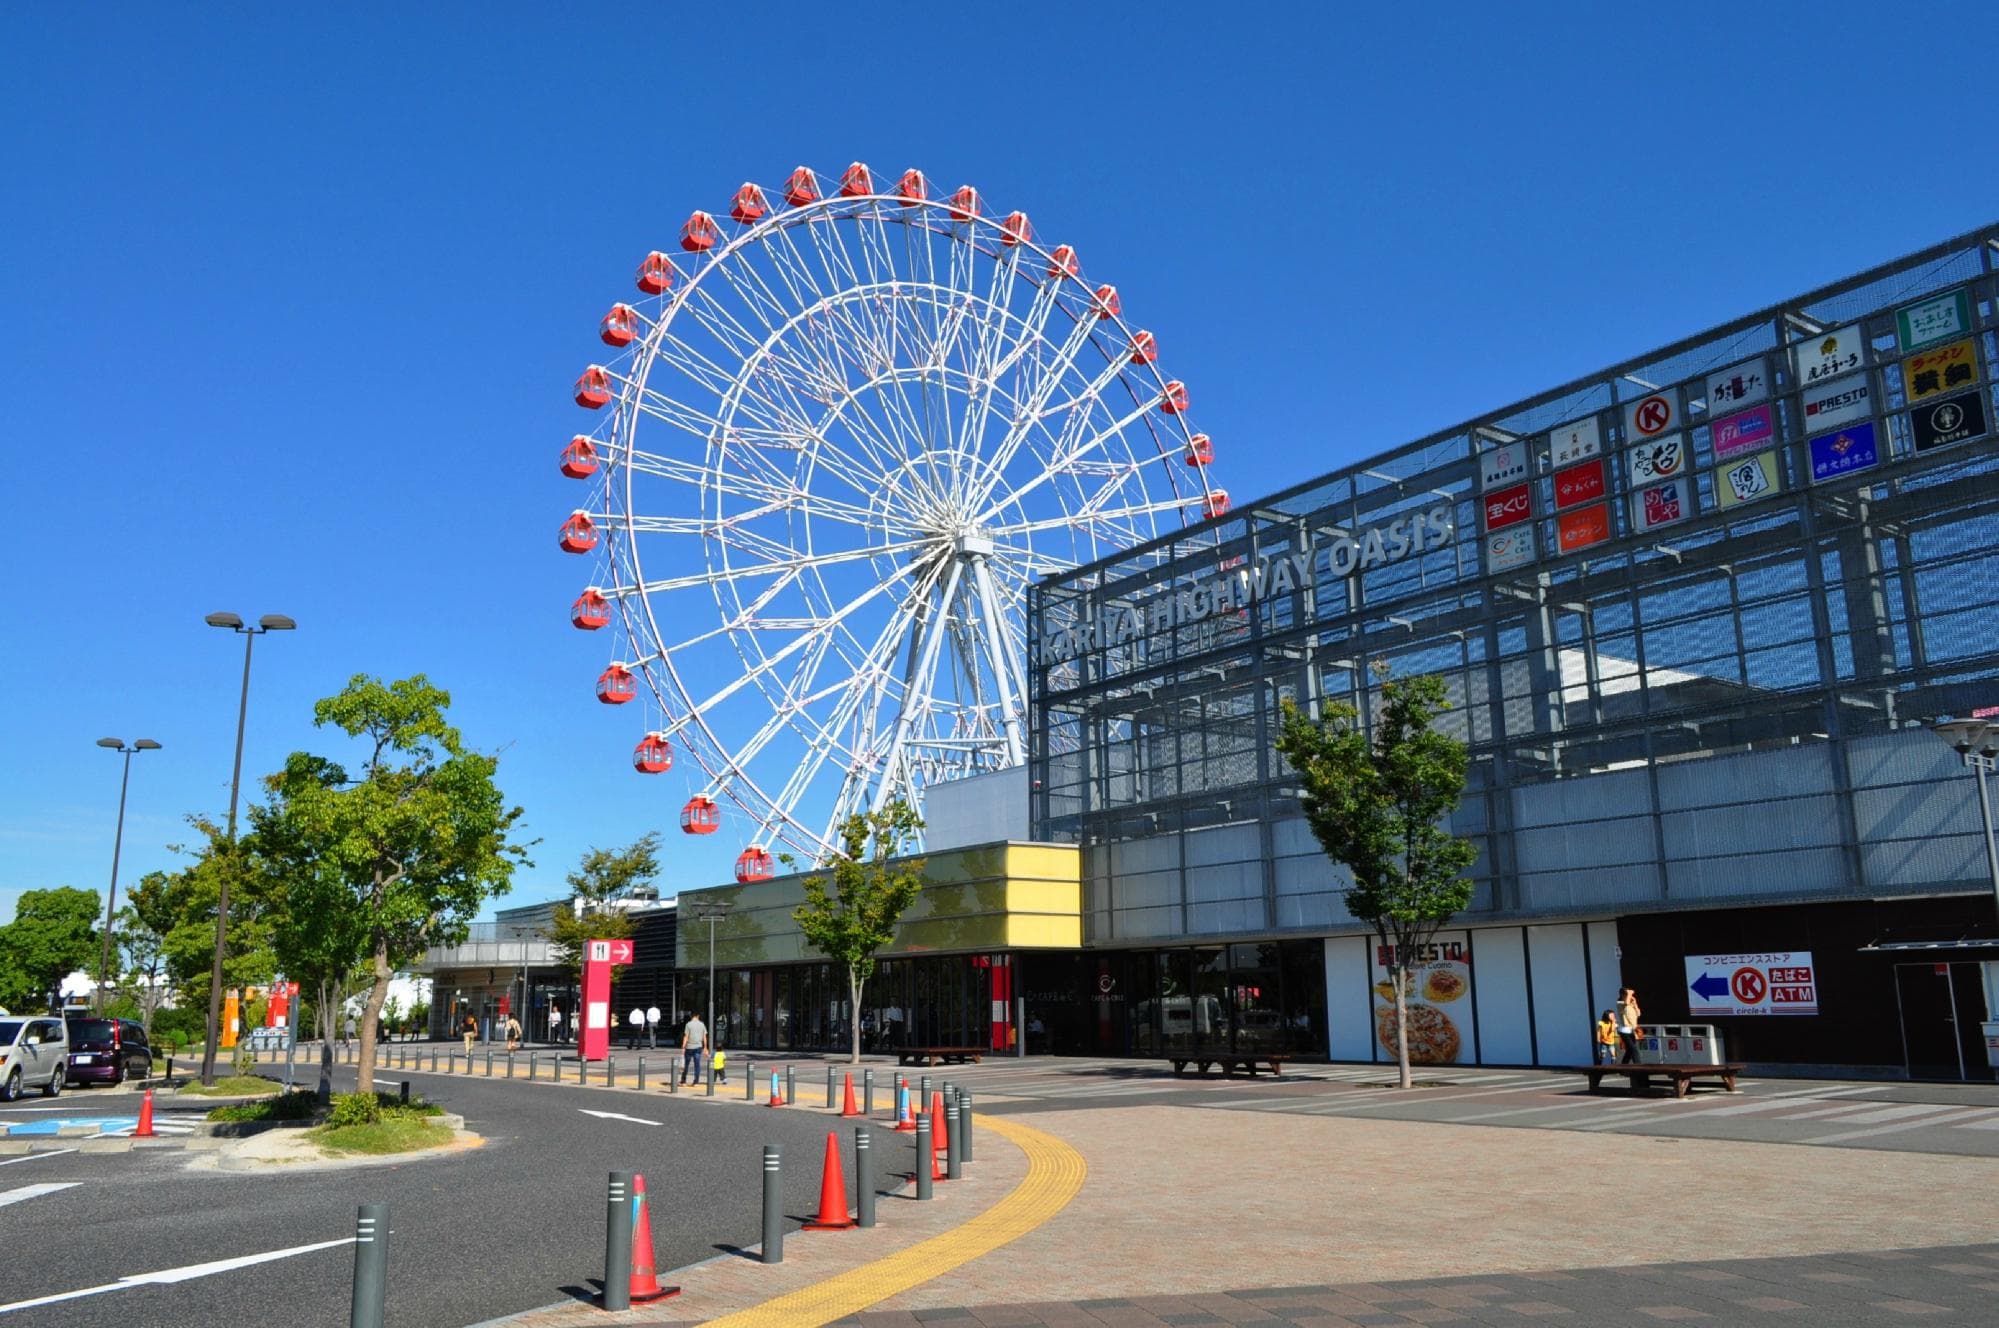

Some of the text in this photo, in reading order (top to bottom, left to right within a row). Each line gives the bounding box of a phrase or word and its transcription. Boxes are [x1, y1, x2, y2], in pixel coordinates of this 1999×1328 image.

[1912, 347, 1964, 371] ラーメン
[1818, 387, 1868, 411] PRESTO
[1488, 494, 1528, 520] 宝くじ
[1040, 505, 1451, 665] KARIYA HIGHWAY OASIS
[1704, 954, 1791, 965] コンビニエンスストア
[1771, 969, 1809, 982] たばこ
[1774, 988, 1811, 1001] ATM
